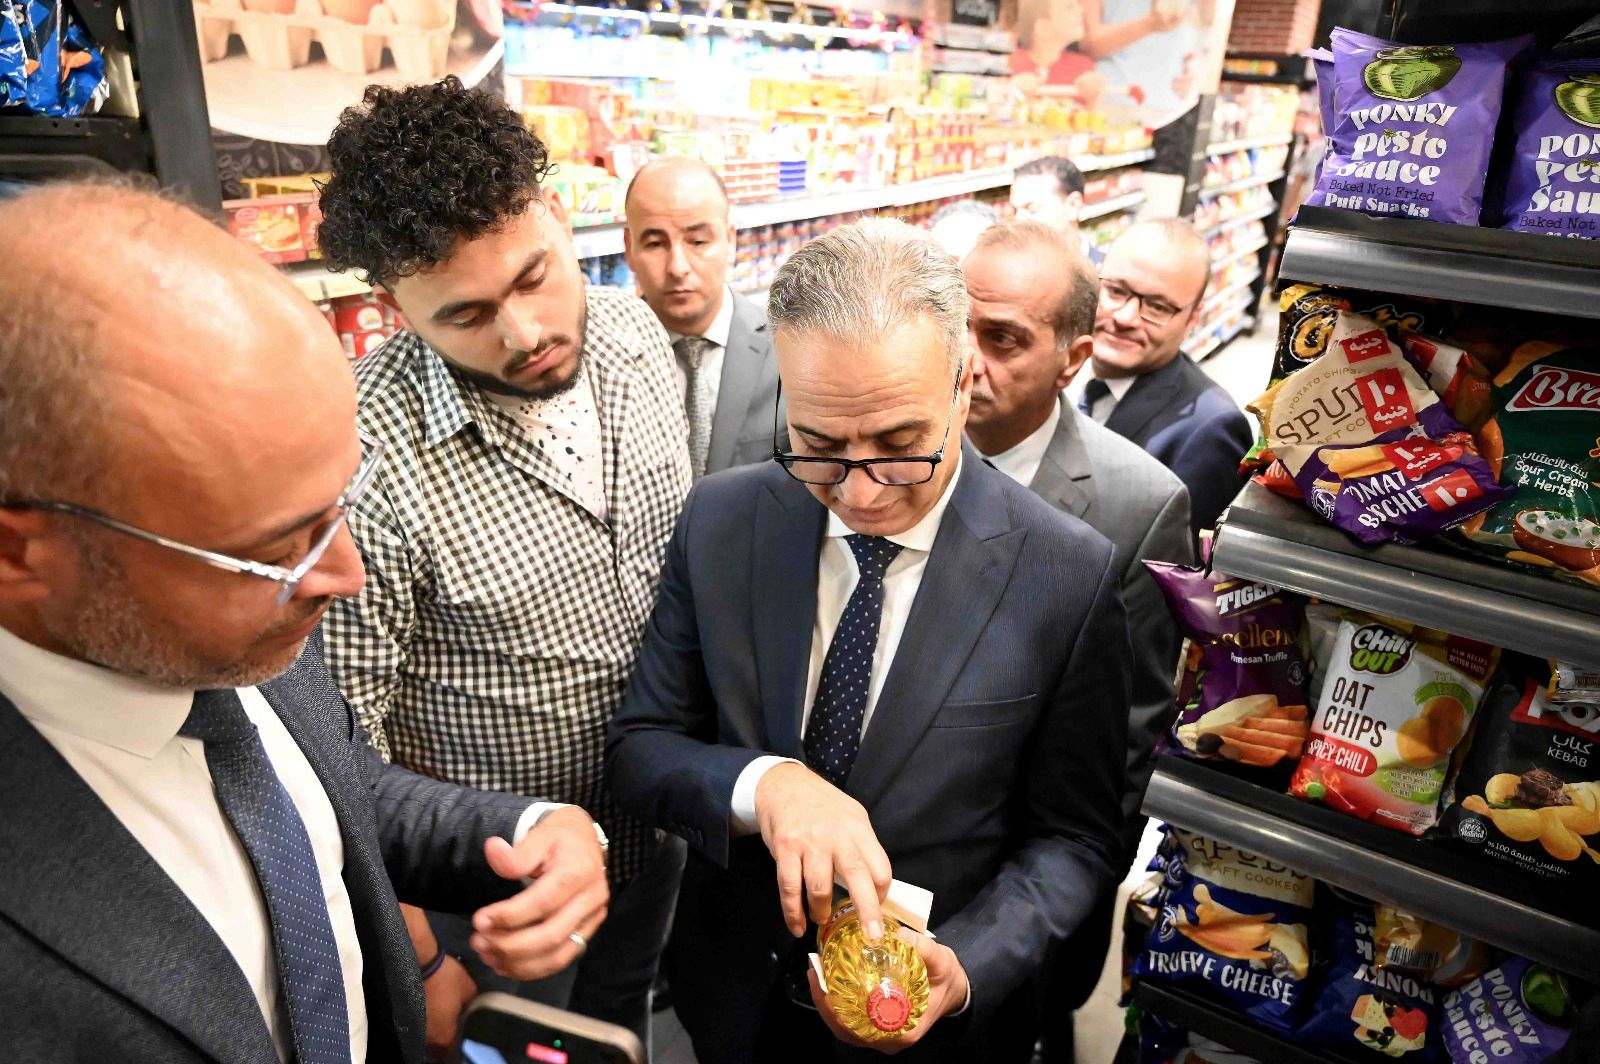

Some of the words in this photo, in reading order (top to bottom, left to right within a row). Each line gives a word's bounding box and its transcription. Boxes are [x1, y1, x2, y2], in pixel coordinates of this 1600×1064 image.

[1351, 103, 1457, 130] PONKY
[1329, 180, 1364, 193] Baked
[1367, 183, 1391, 196] Not
[1395, 187, 1435, 202] Fried
[1325, 193, 1363, 210] Puff
[1366, 198, 1430, 218] Snacks
[1520, 216, 1562, 229] Baked
[1567, 217, 1597, 231] Not
[1290, 377, 1321, 411] POTATO
[1325, 367, 1358, 379] CHIPS
[1515, 460, 1545, 476] Sour
[1548, 470, 1589, 492] Cream
[1518, 473, 1530, 487] &
[1534, 478, 1576, 498] Herbs
[1353, 649, 1402, 673] OUT
[1331, 676, 1375, 711] OAT
[1322, 705, 1387, 748] CHIPS
[1547, 746, 1588, 768] KEBAB
[1552, 734, 1593, 755] كباب
[1335, 747, 1369, 774] CHILI
[1244, 871, 1302, 892] COOKED
[1220, 964, 1295, 1006] CHEESE
[1484, 967, 1541, 1044] PONKY
